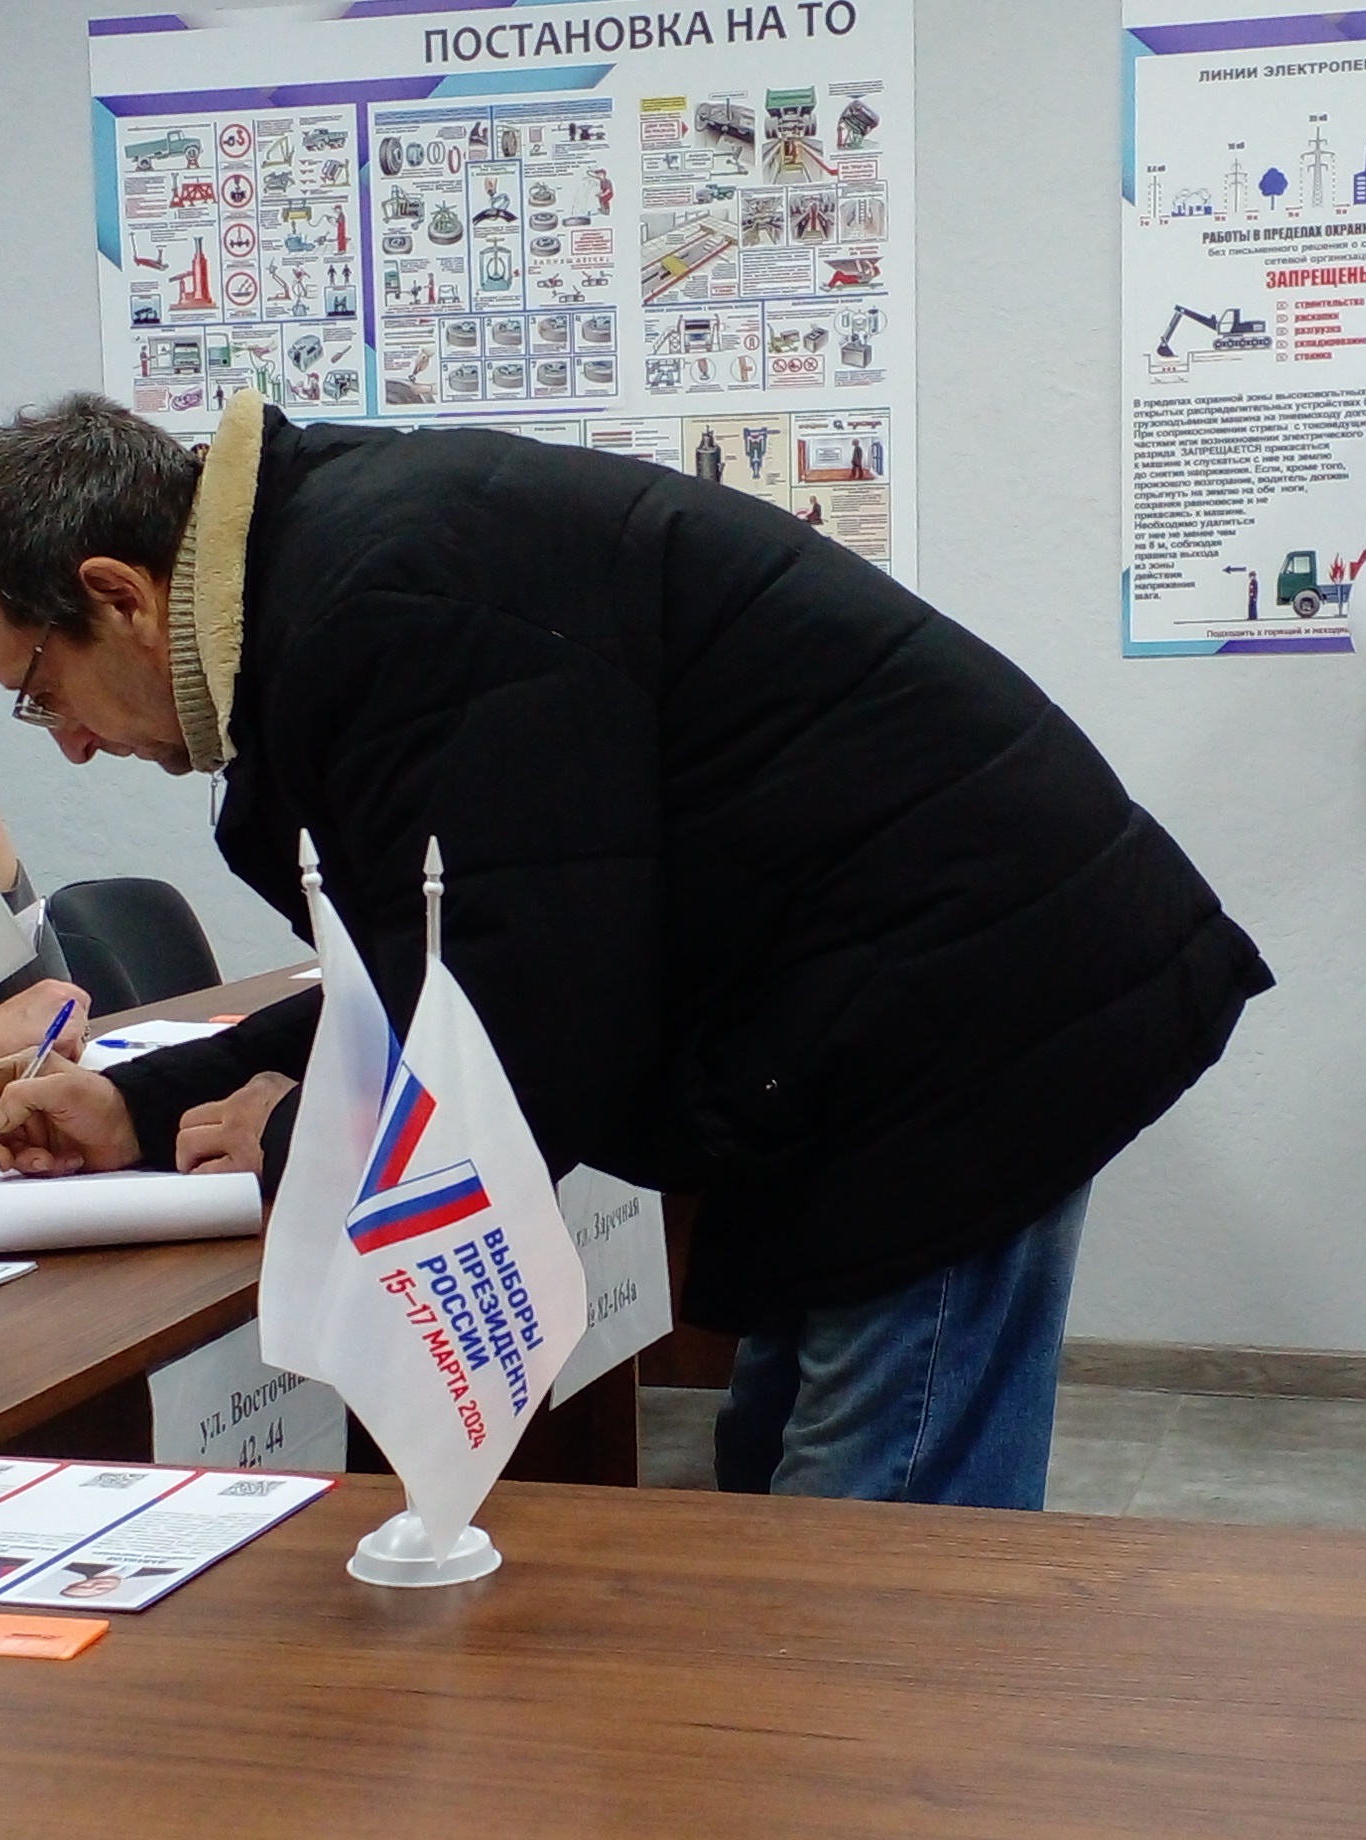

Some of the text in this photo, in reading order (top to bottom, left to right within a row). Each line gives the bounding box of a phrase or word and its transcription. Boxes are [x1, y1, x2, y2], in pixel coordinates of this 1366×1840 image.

[424, 0, 857, 64] ПОСТАНОВКА НА ТО
[1198, 66, 1259, 83] ЛИНИИ
[1202, 230, 1251, 244] РАБОТЫ
[1253, 230, 1260, 241] В
[1264, 226, 1323, 242] ПРЕДЕЛАХ
[1228, 244, 1299, 256] письменного
[1301, 241, 1348, 253] решения
[1264, 254, 1307, 266] сетевой
[1181, 445, 1262, 456] ЗАПРЕЩАЕТСЯ
[416, 1253, 491, 1374] РОССИИ
[481, 1226, 544, 1352] ВЫБОРЫ
[453, 1240, 536, 1419] ПРЕЗИДЕНТА
[199, 1371, 310, 1454] ул. Восточна
[421, 1328, 472, 1403] МАРТА
[455, 1399, 487, 1451] 2024
[238, 1416, 284, 1468] 42, 44
